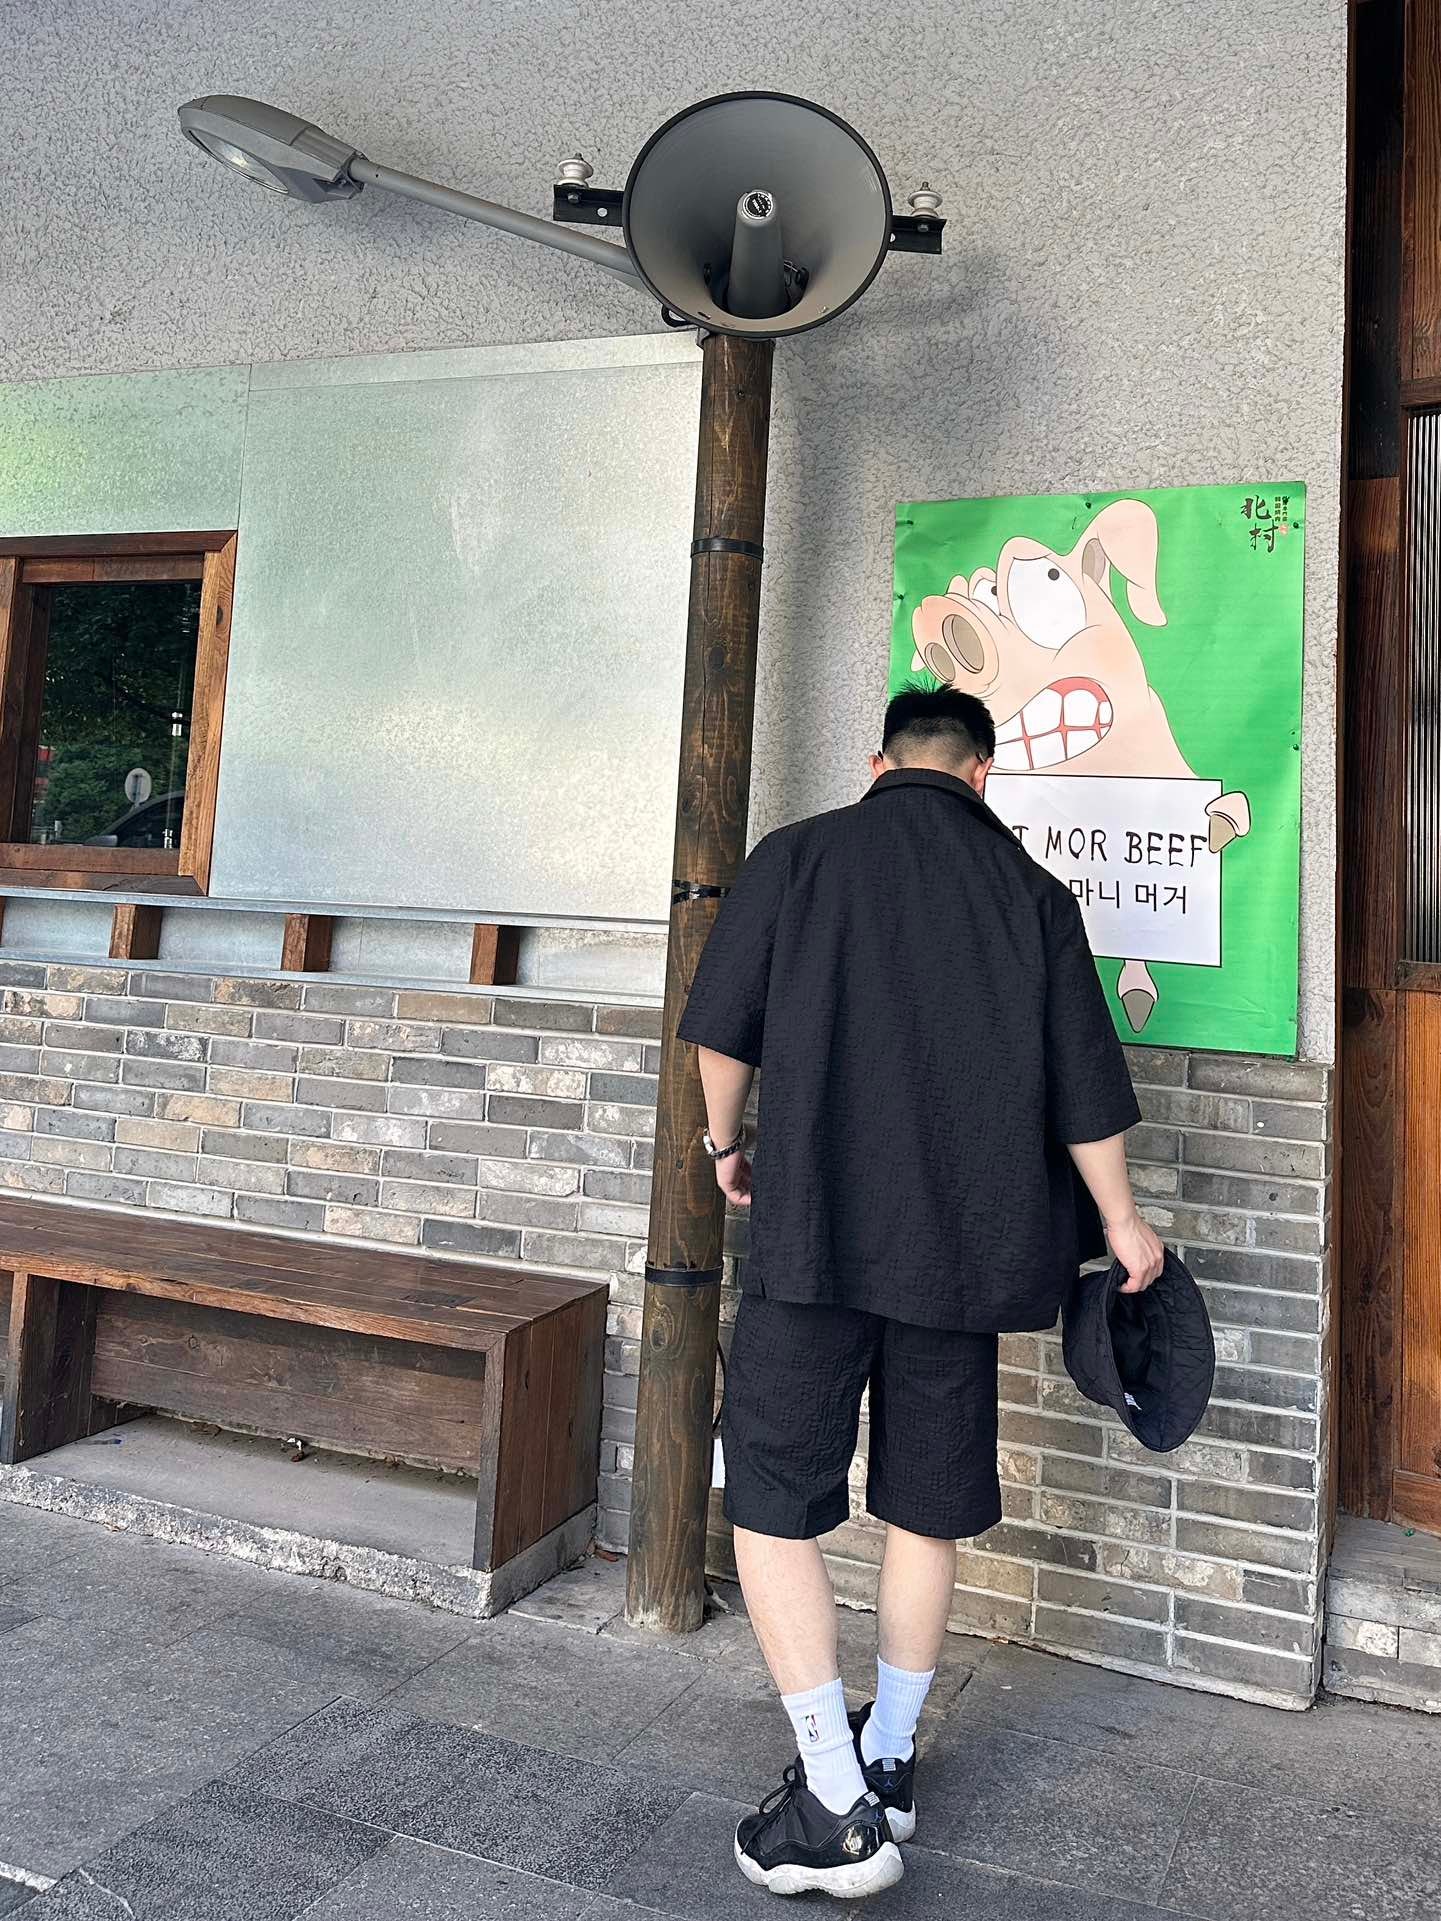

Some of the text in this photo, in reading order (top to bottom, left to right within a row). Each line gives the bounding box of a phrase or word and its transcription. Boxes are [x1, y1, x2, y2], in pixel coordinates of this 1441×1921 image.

[1240, 494, 1279, 553] 北村
[1045, 826, 1107, 862] MOR
[1124, 831, 1208, 868] BEEF
[1069, 878, 1187, 914] 마니 머거
